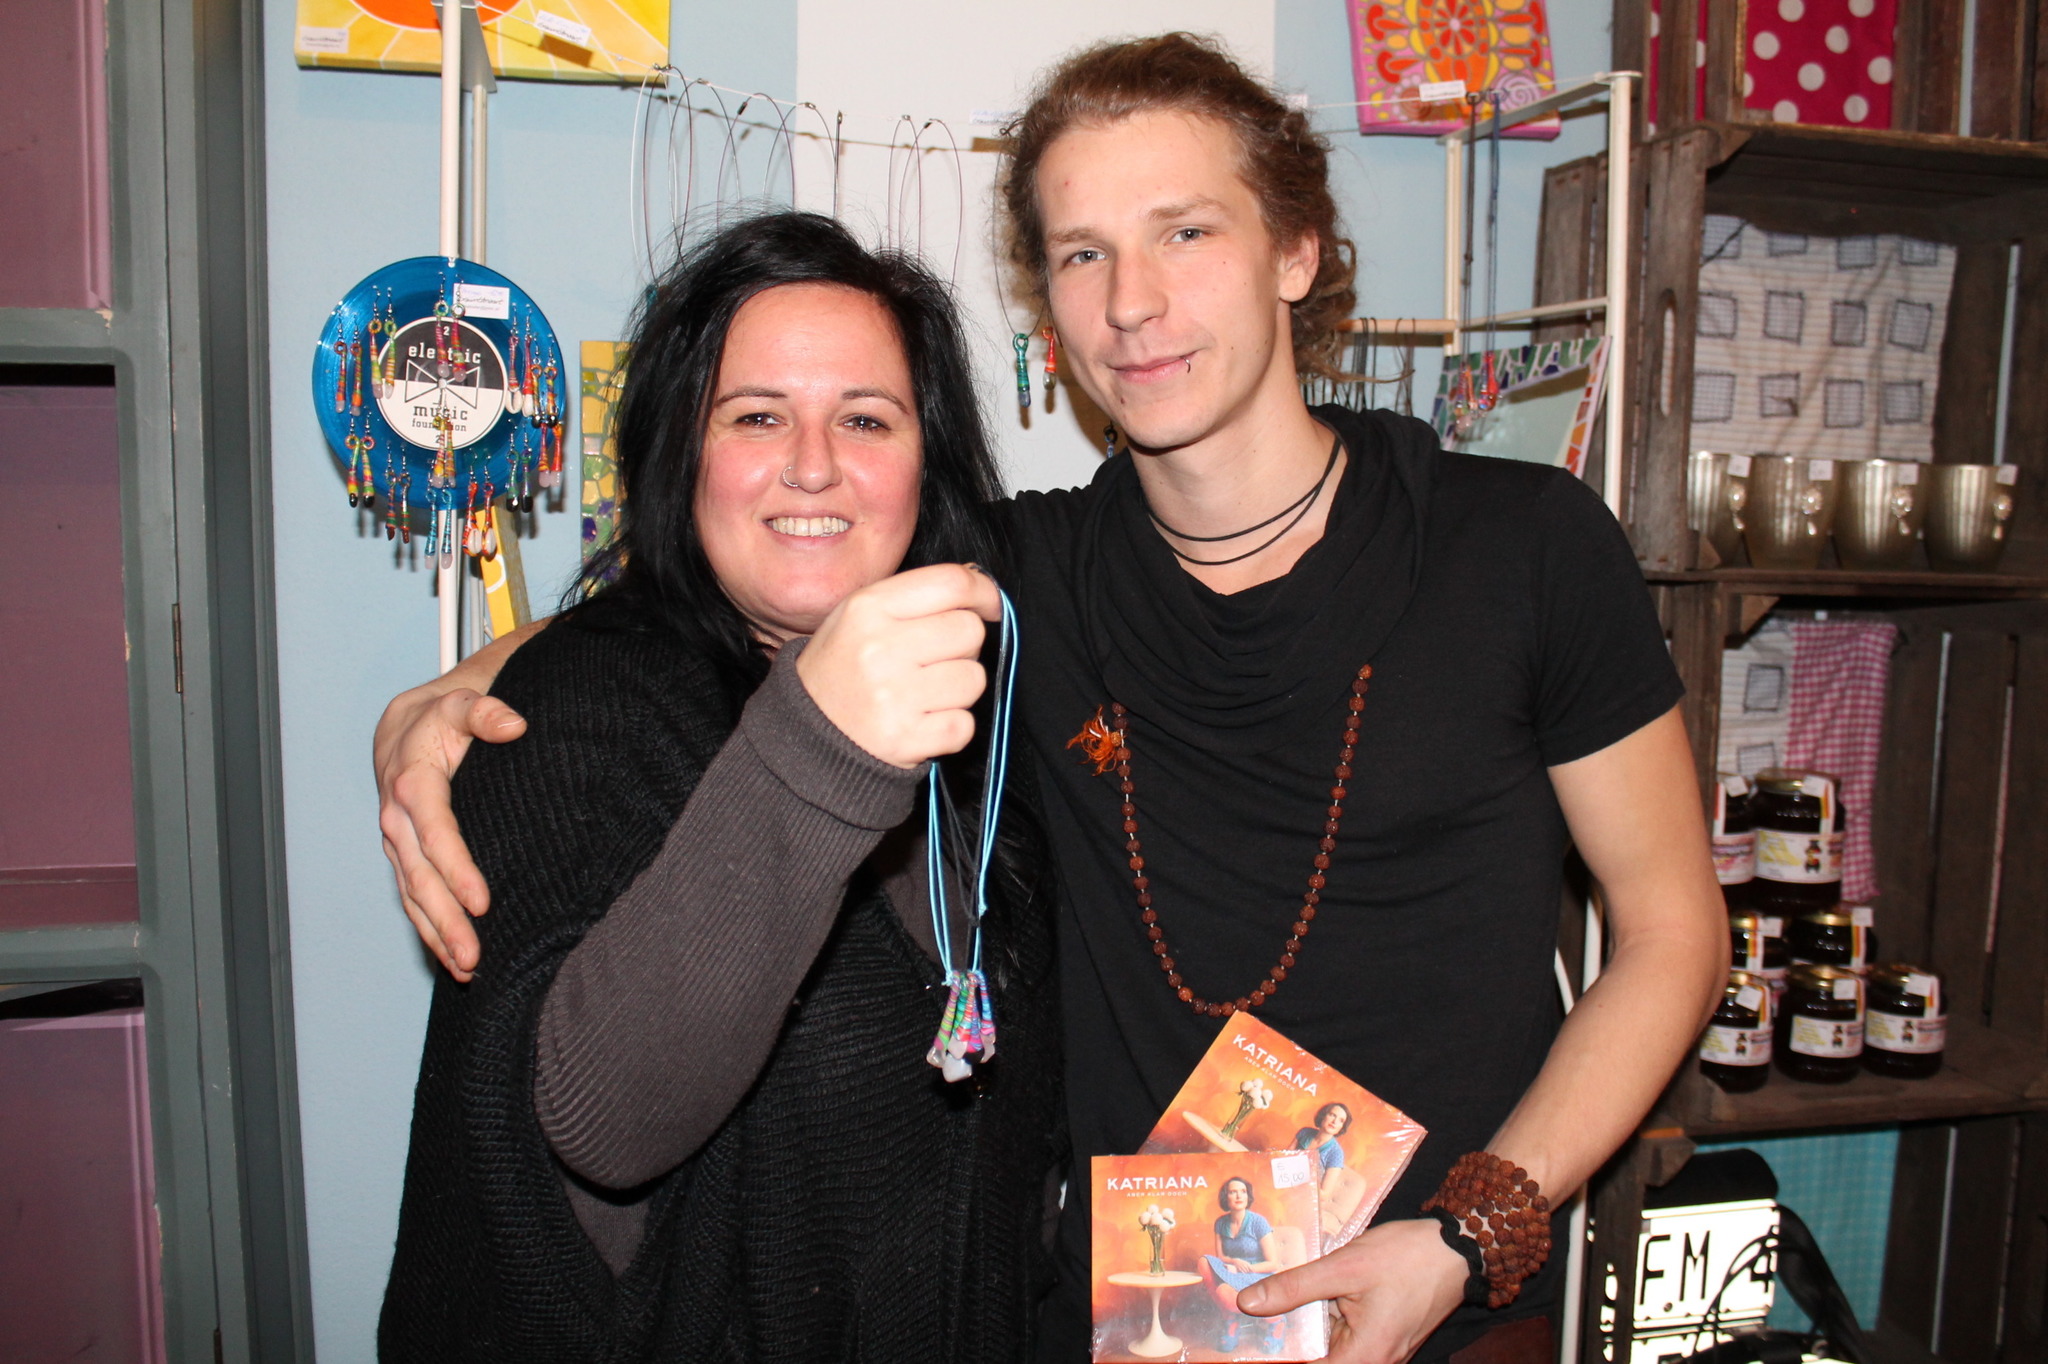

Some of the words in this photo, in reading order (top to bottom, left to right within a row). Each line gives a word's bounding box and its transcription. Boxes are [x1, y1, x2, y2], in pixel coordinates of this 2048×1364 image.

[443, 325, 450, 336] 2
[408, 342, 482, 364] eletic
[412, 418, 467, 432] founon
[1232, 1034, 1318, 1097] KATRIANA
[1106, 1175, 1209, 1191] KATRIANA
